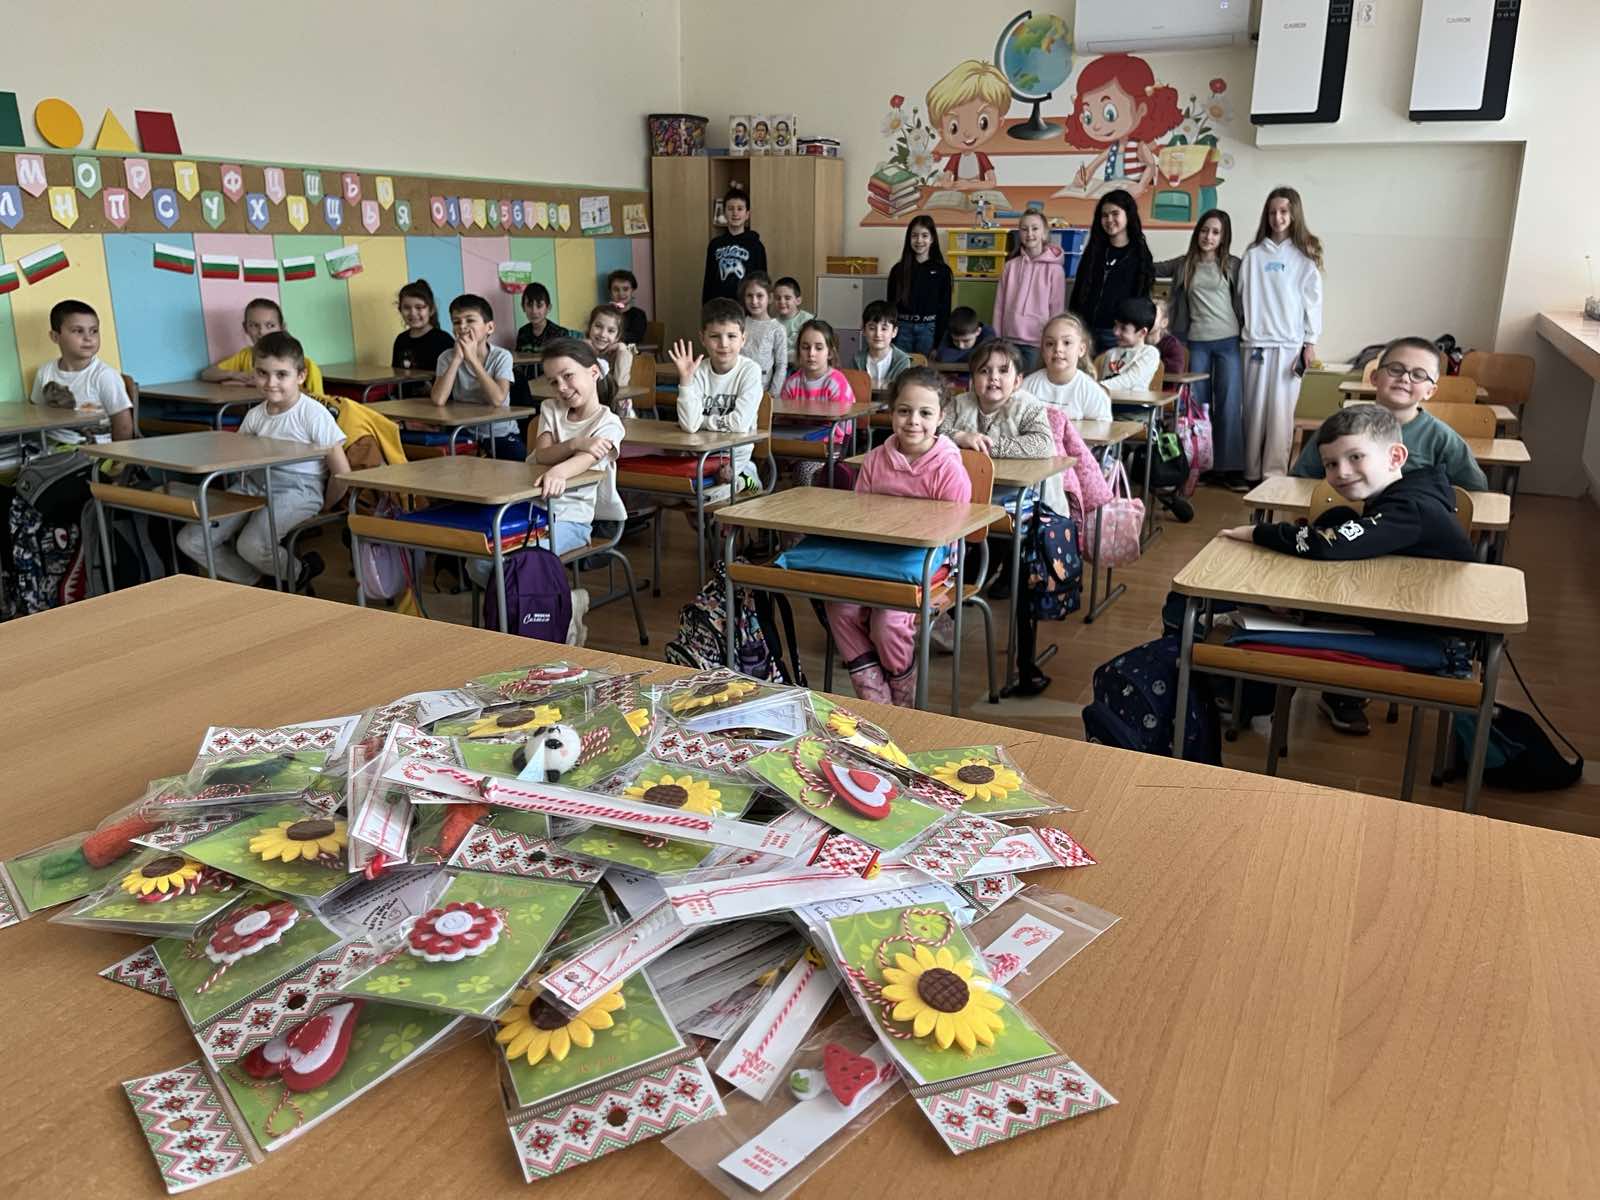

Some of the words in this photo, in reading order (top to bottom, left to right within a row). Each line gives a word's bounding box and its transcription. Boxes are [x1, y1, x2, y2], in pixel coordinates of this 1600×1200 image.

[19, 159, 45, 185] М
[77, 162, 97, 188] О
[130, 165, 147, 189] Р
[178, 167, 194, 193] Т
[223, 170, 242, 193] Ф
[269, 170, 283, 195] Ц
[306, 174, 321, 197] Ш
[345, 177, 359, 198] Ъ
[54, 193, 74, 219] Н
[108, 194, 126, 220] П
[157, 194, 175, 219] С
[205, 196, 219, 221] У
[250, 199, 266, 221] Х
[292, 203, 306, 225] Ч
[326, 198, 342, 226] Щ
[397, 205, 411, 226] Я
[449, 203, 458, 221] 1
[463, 203, 473, 220] 2
[489, 205, 498, 221] 4
[501, 205, 509, 222] 5
[513, 204, 523, 222] 6
[549, 207, 557, 222] 9
